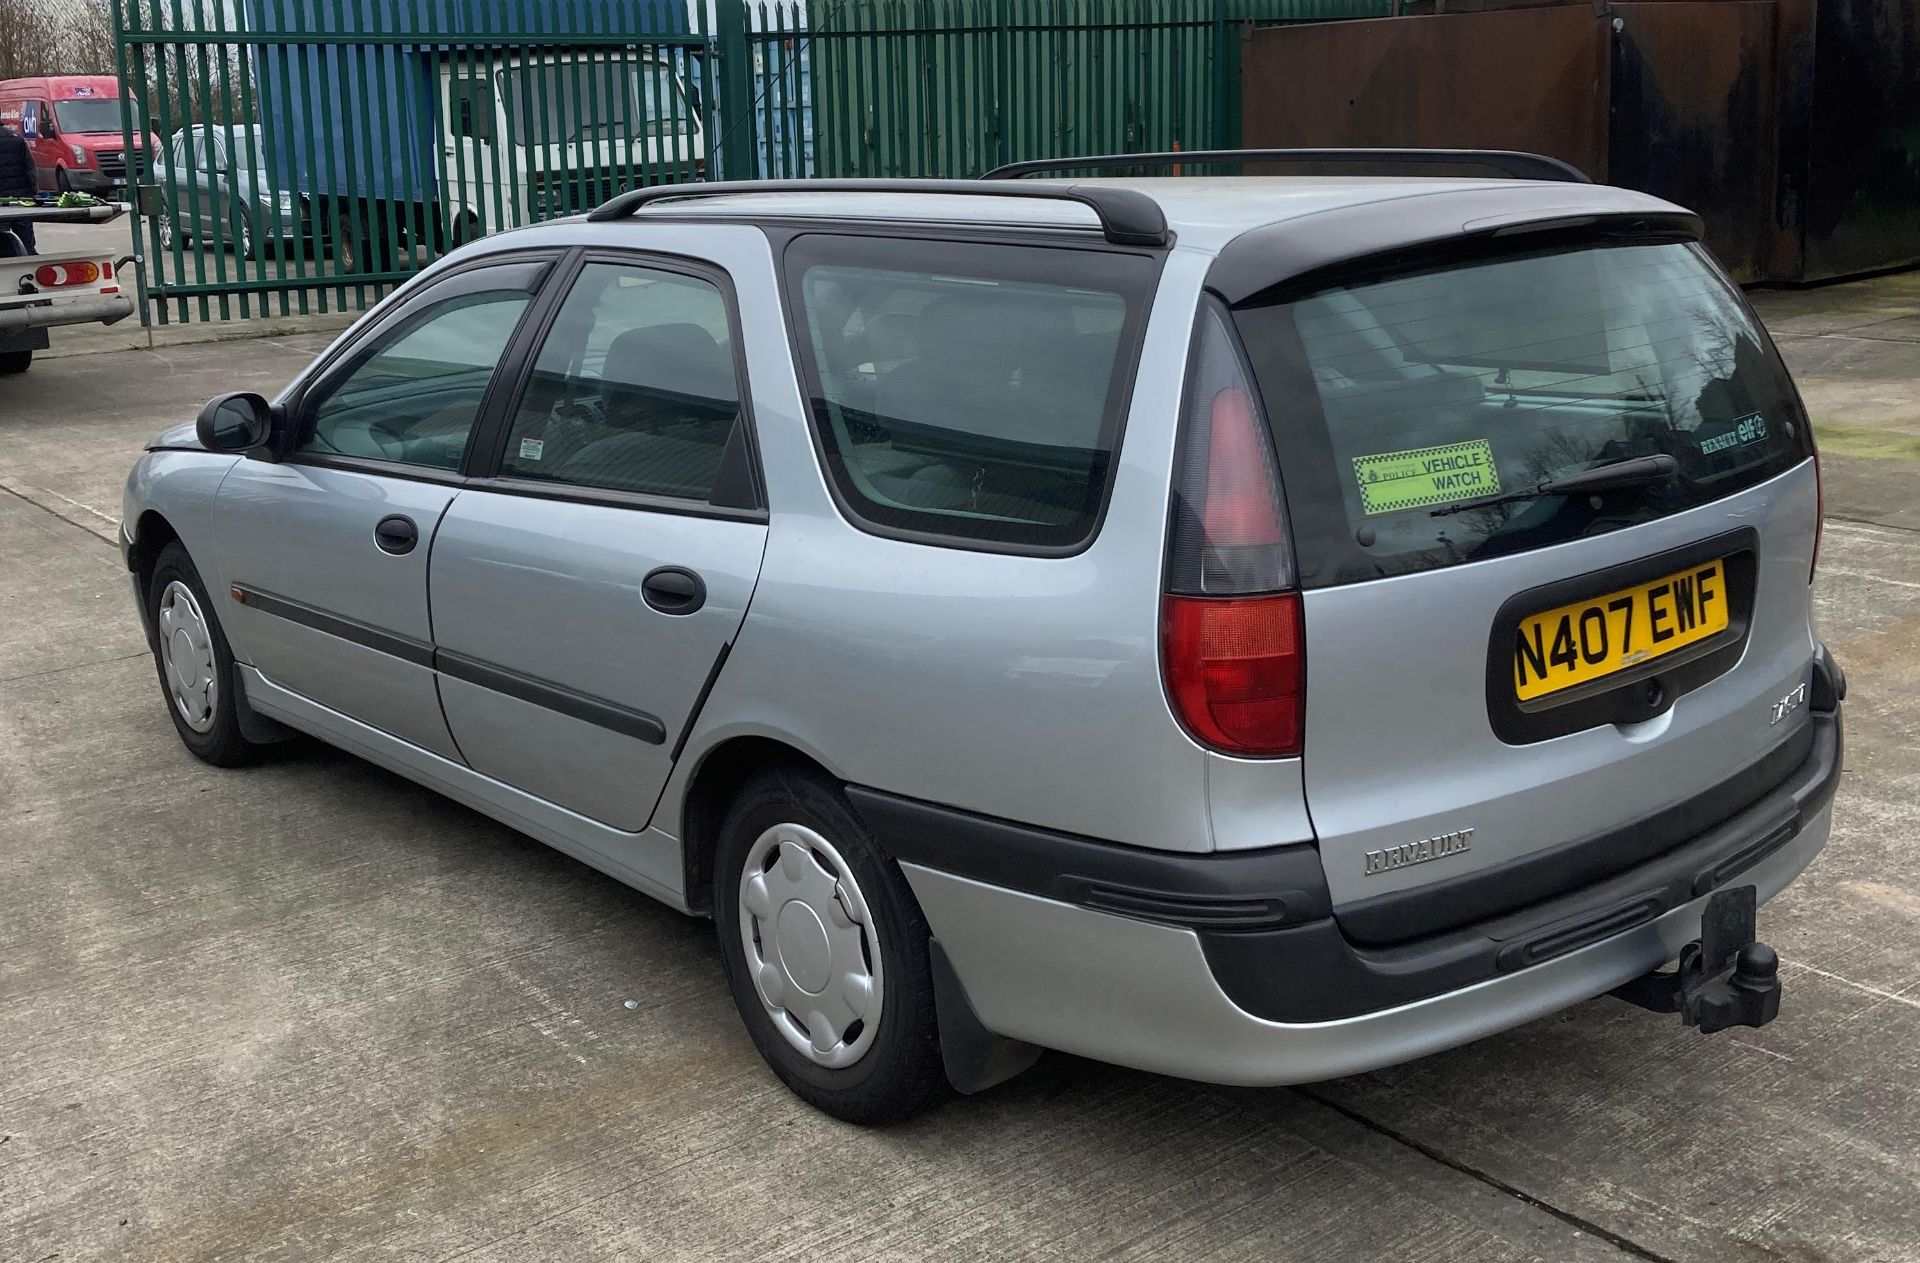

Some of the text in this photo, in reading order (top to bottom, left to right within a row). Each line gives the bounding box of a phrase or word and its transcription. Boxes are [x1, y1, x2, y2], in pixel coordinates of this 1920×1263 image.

[1422, 452, 1481, 474] VEHICLE
[1382, 469, 1417, 480] POLICE
[1431, 471, 1482, 490] WATCH
[1515, 567, 1717, 687] N407 EWF
[1365, 828, 1475, 876] RENAULT
